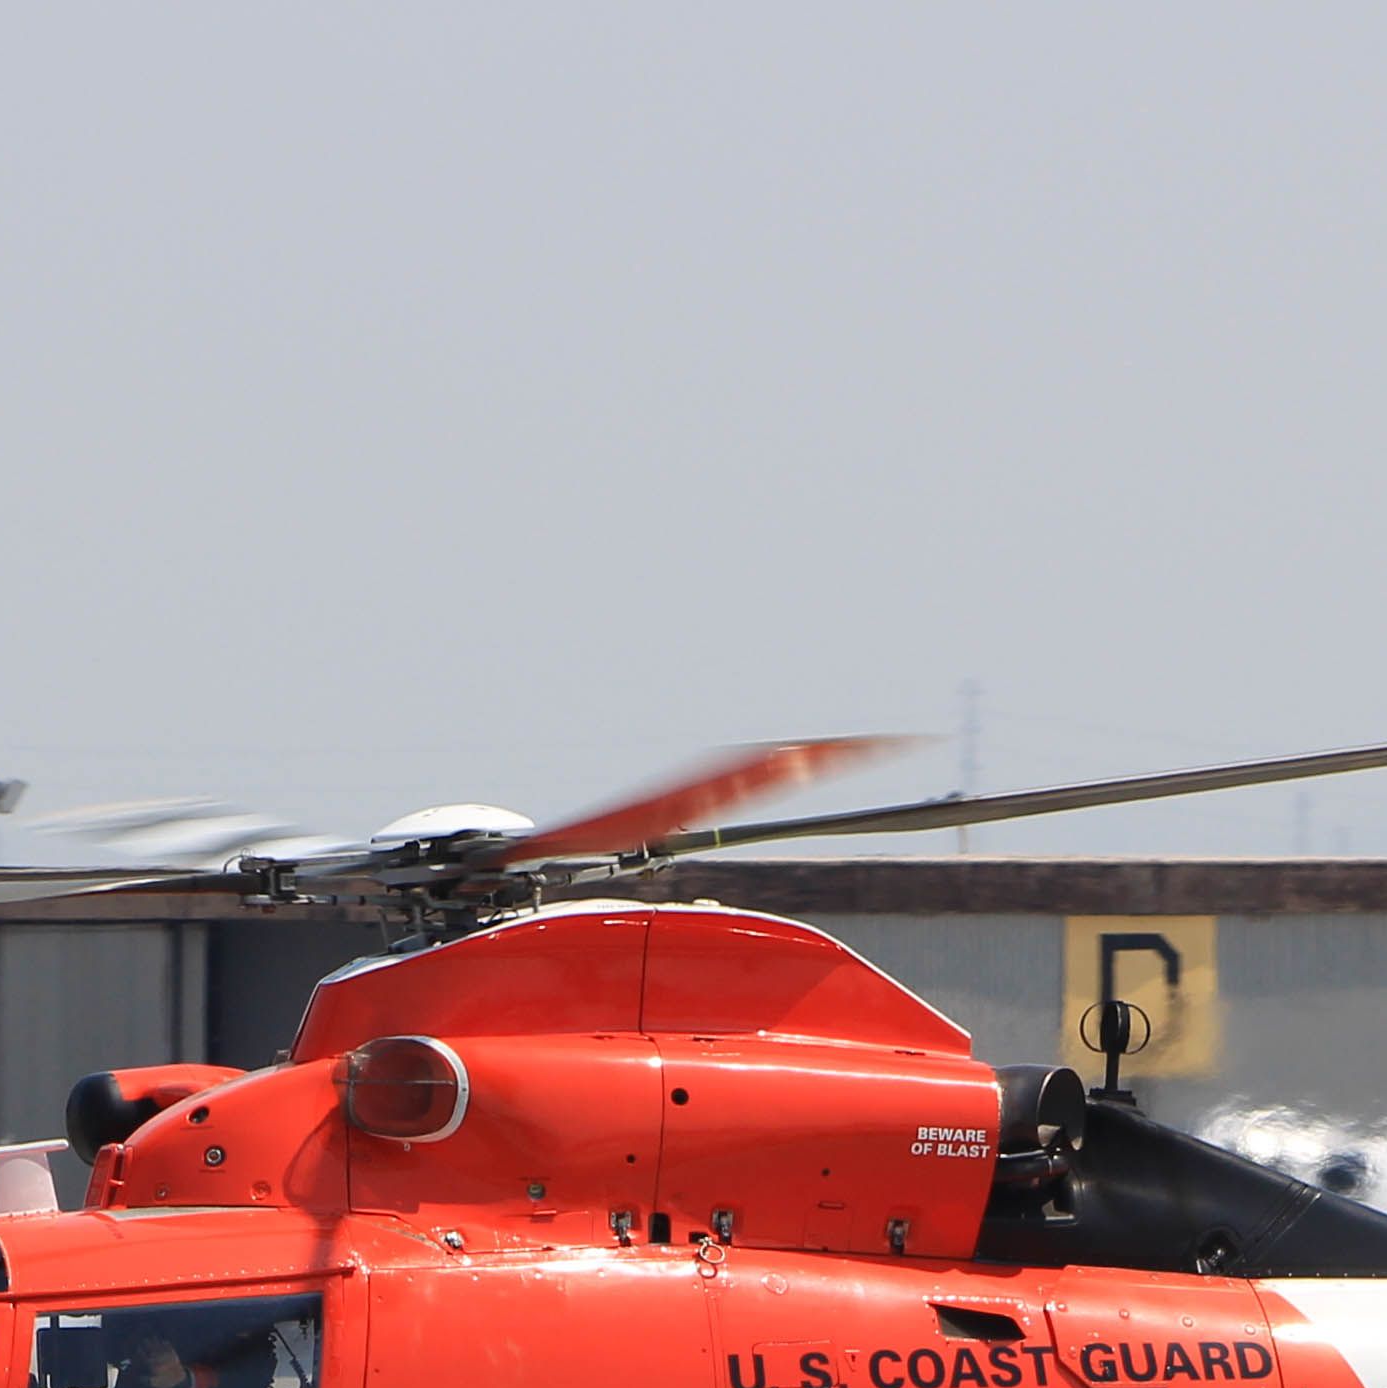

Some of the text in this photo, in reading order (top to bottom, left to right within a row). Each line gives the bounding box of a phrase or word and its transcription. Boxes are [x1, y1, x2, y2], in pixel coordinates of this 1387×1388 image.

[917, 1126, 987, 1143] BEWARE
[911, 1142, 991, 1158] OF BLAST
[1079, 1341, 1273, 1382] GUARD
